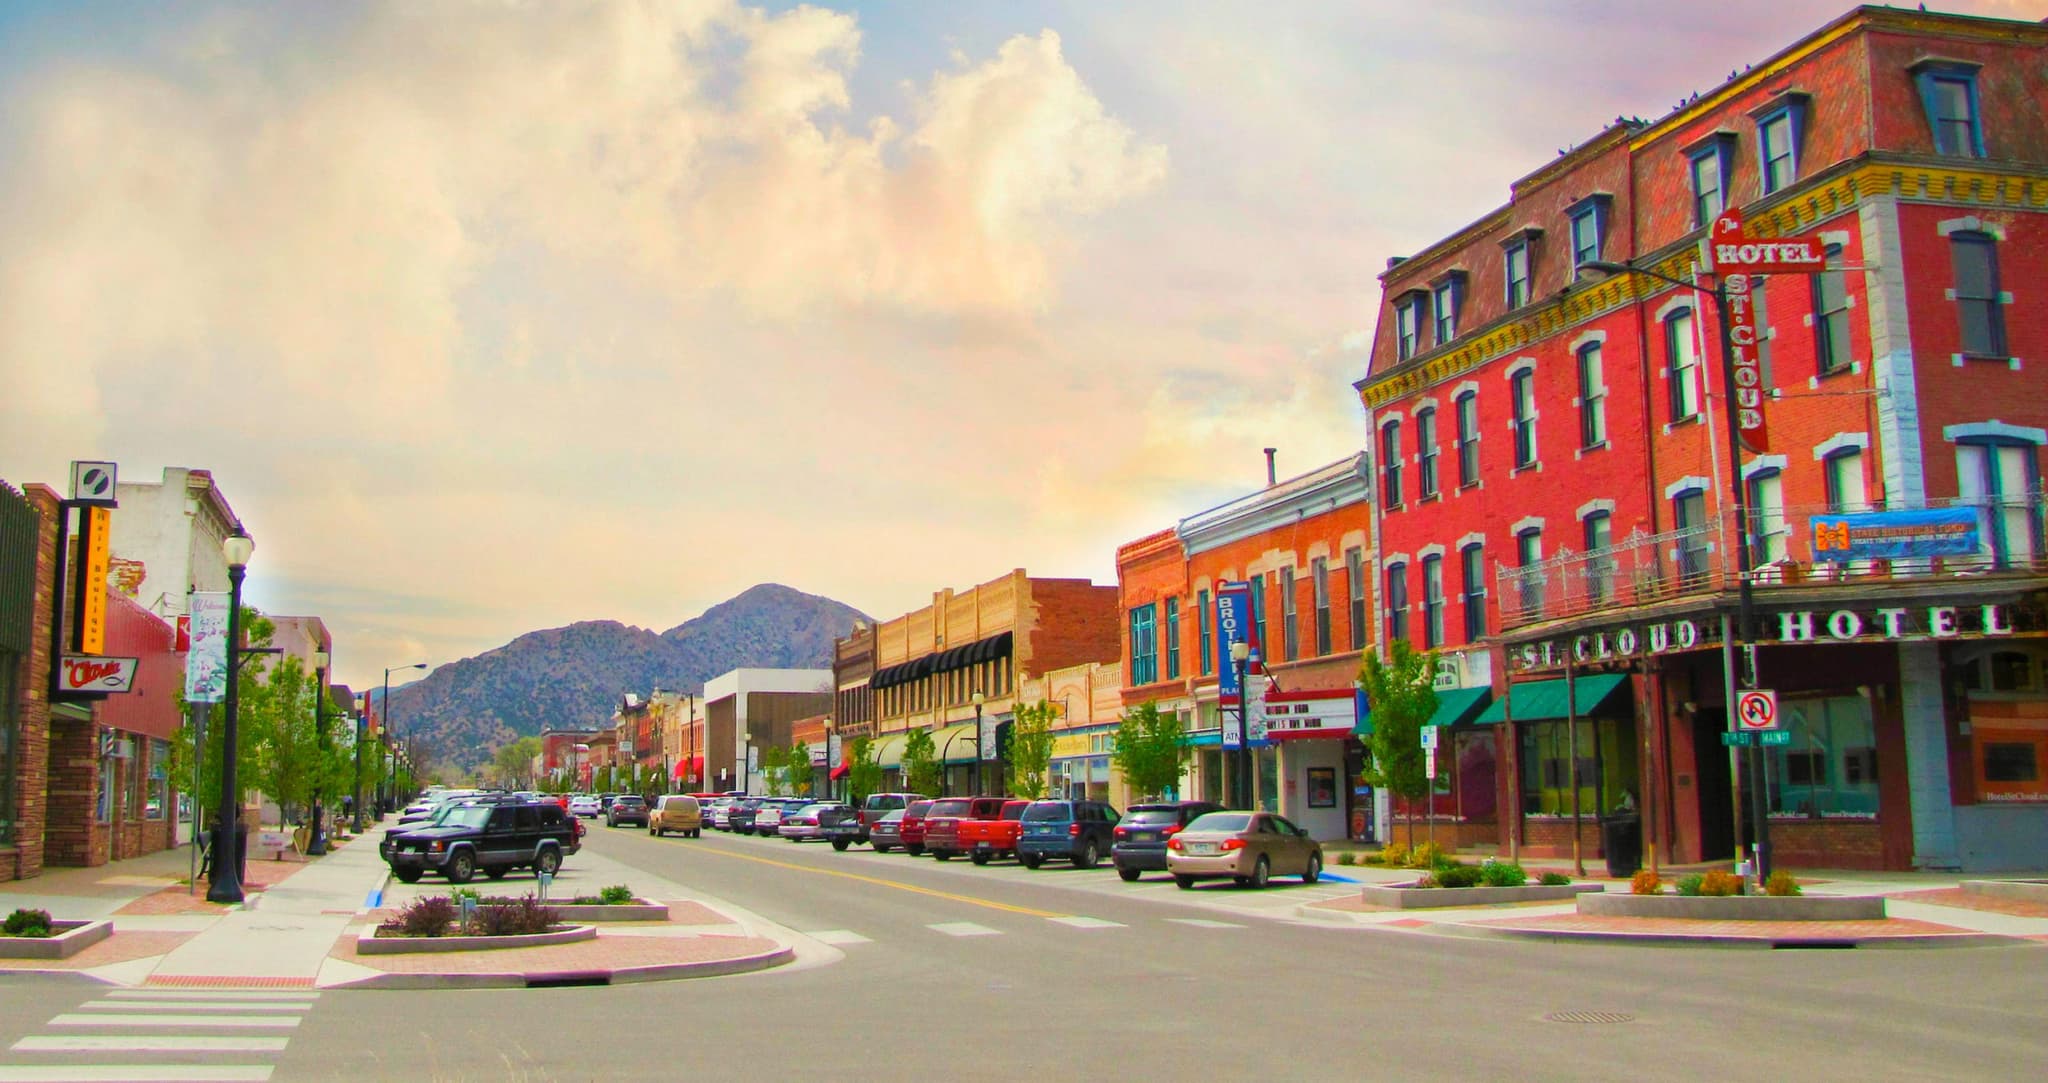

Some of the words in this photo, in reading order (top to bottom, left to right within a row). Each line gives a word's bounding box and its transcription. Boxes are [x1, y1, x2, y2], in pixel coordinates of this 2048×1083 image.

[1716, 243, 1822, 264] HOTEL
[1730, 325, 1763, 430] CLOUD
[1851, 528, 1878, 538] STATE
[1218, 597, 1240, 686] BROT
[1572, 620, 1697, 662] CLOUD
[1777, 604, 2016, 642] HOTEL
[1761, 731, 1781, 744] MAIN
